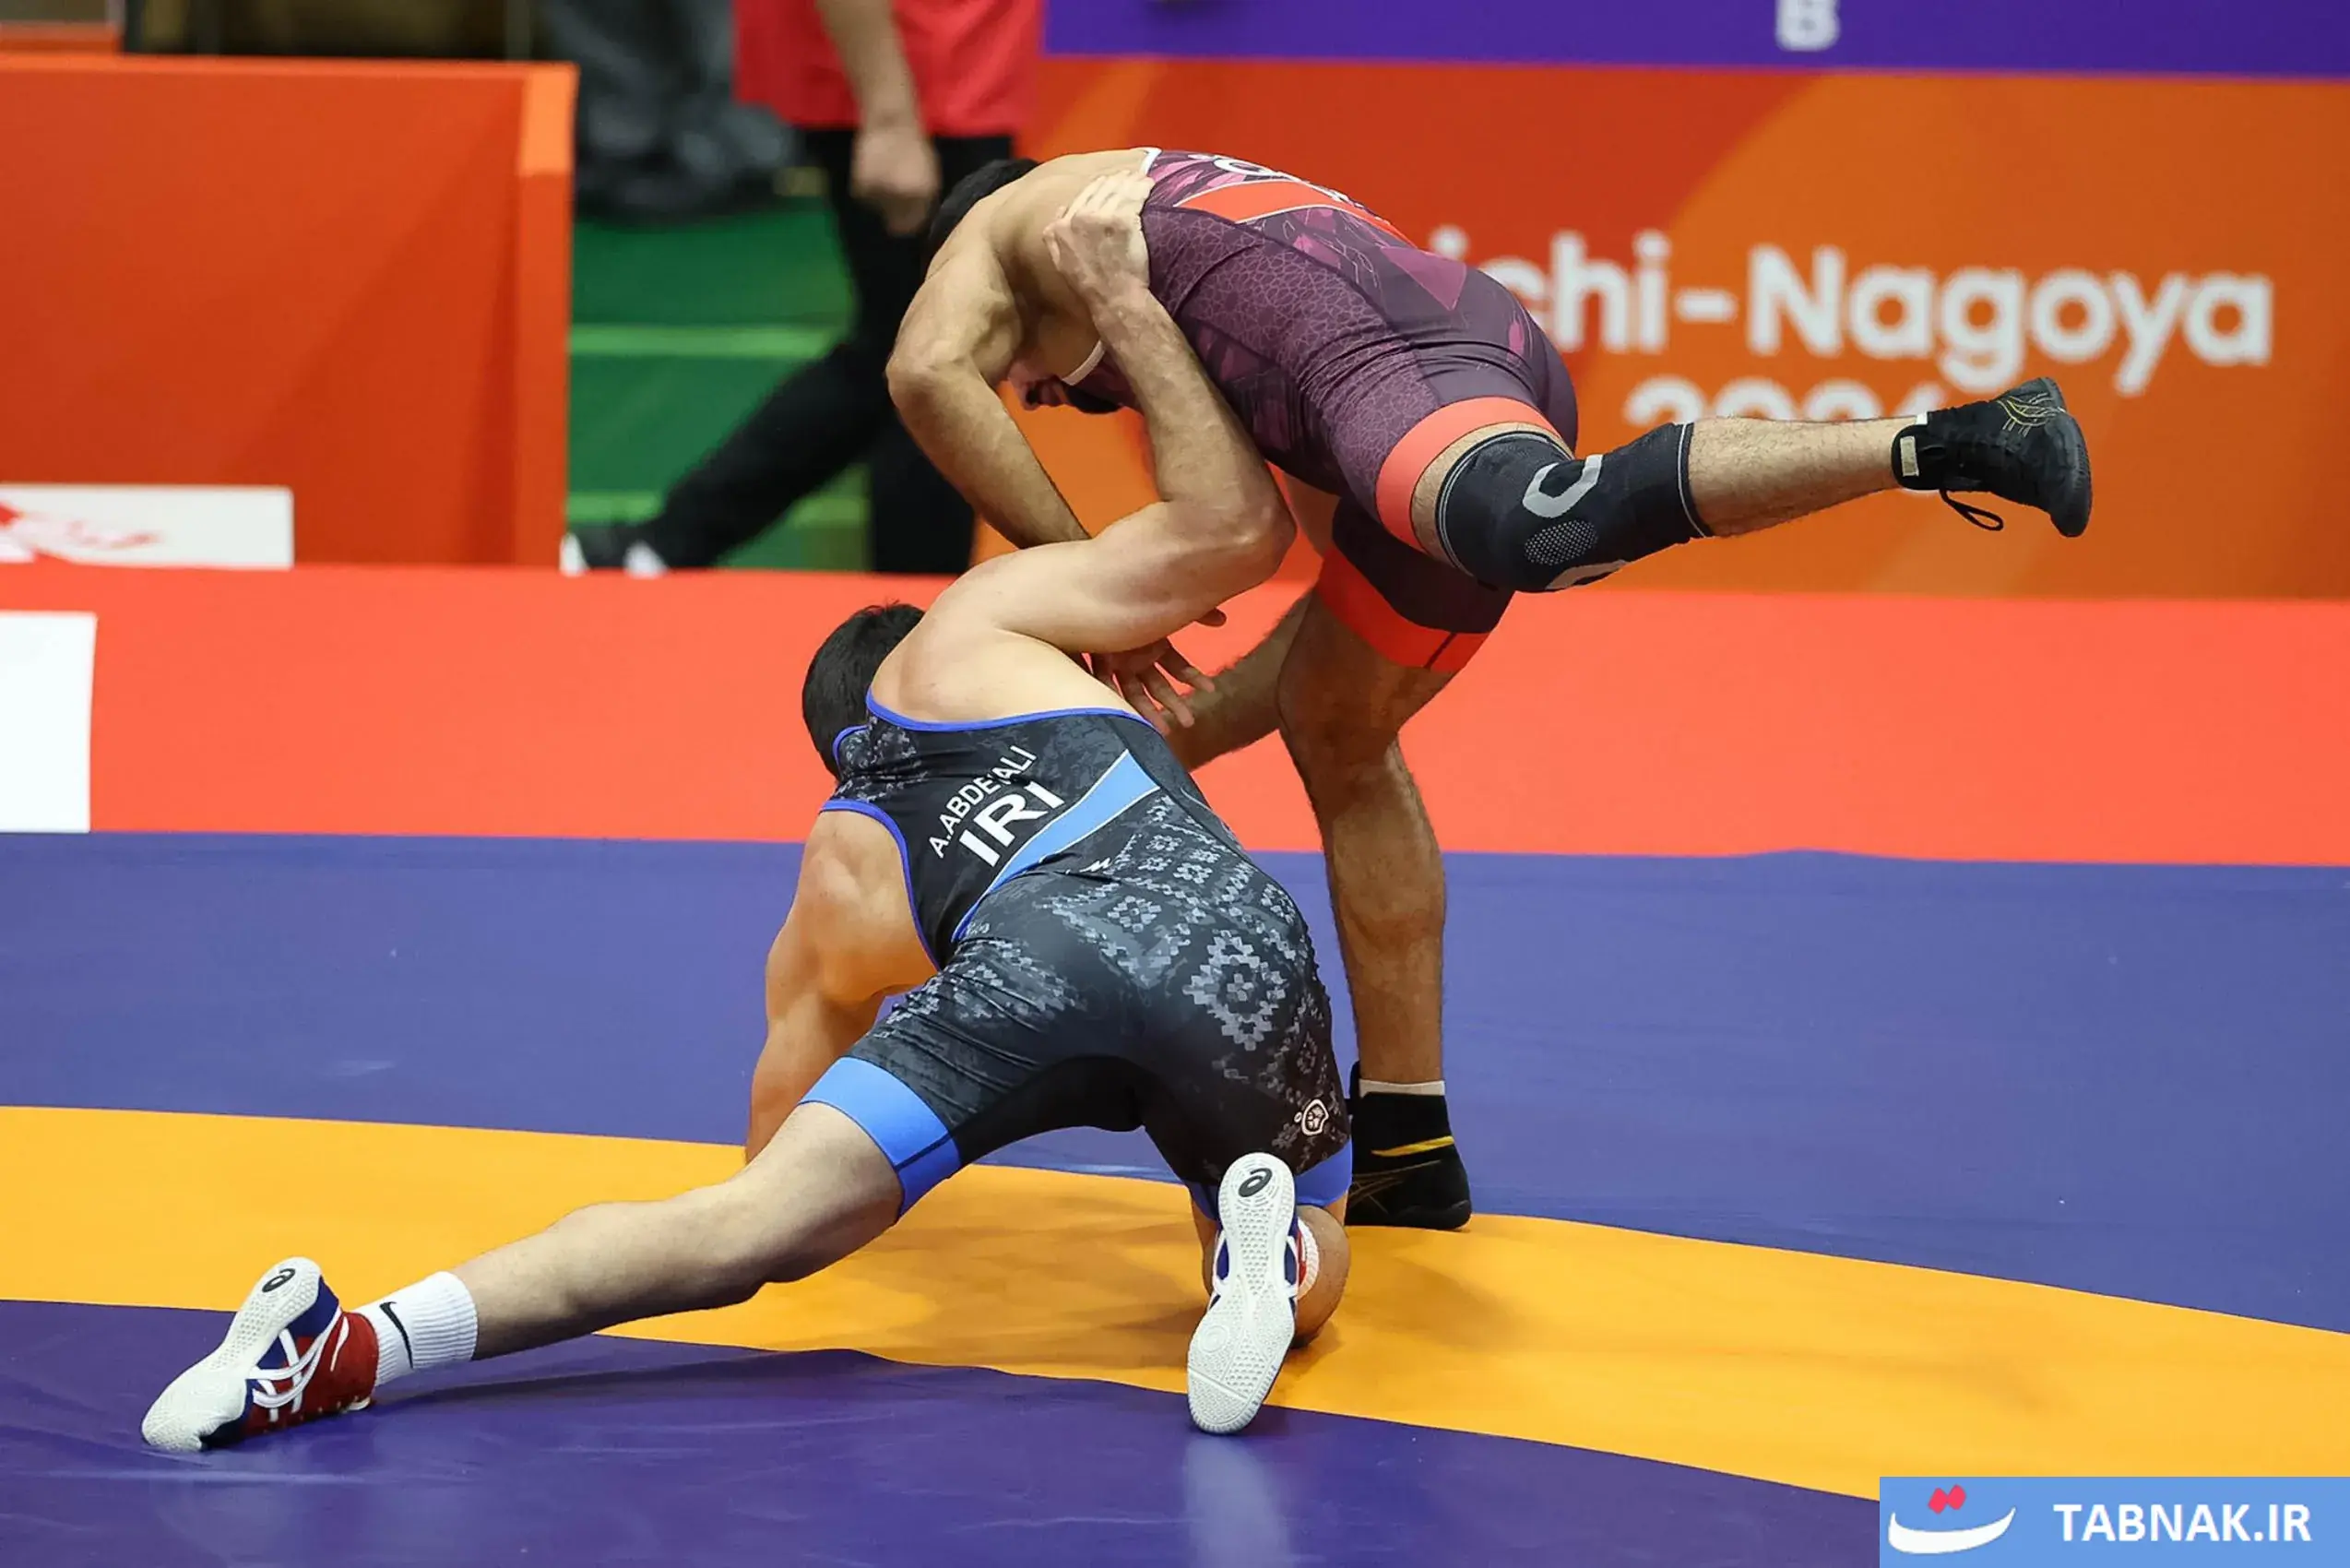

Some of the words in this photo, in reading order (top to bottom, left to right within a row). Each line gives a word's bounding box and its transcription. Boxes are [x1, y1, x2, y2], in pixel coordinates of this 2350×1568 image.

[1775, 0, 1841, 51] B
[929, 745, 1037, 859] A.ABDEALI
[959, 781, 1065, 867] IRI
